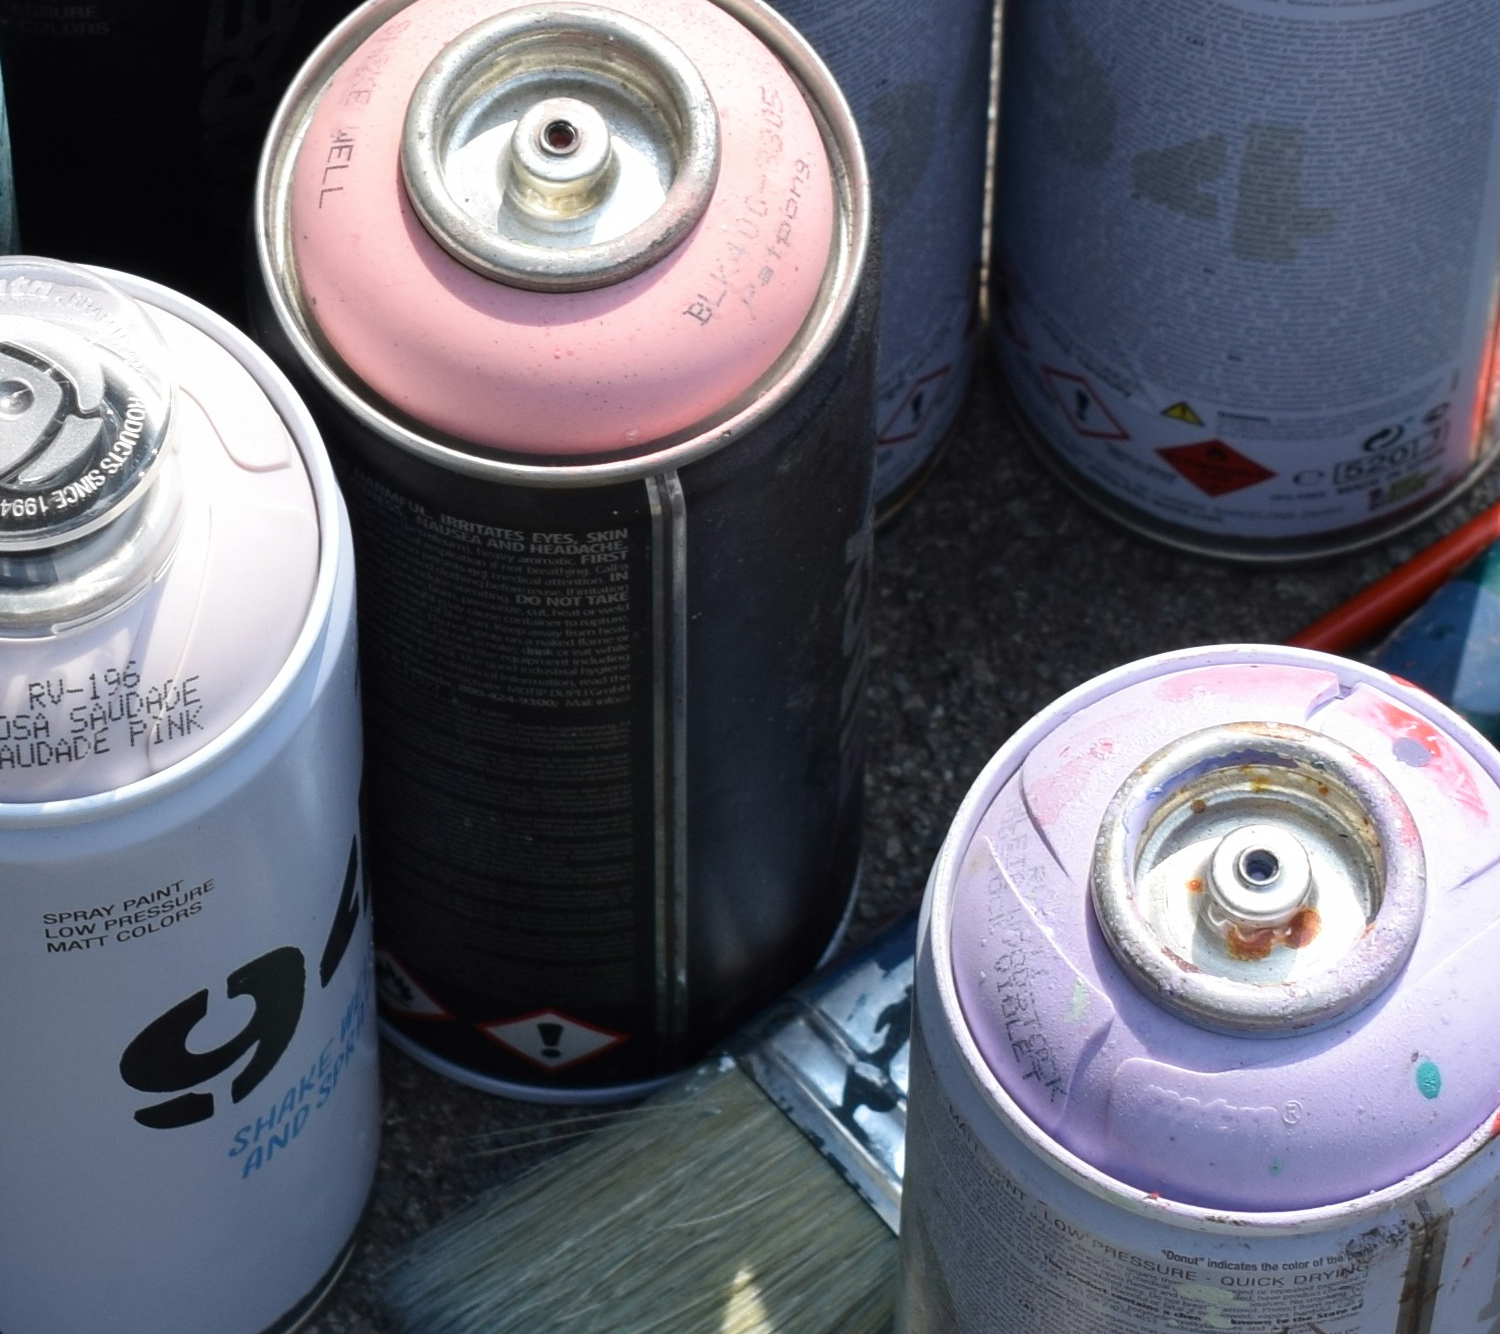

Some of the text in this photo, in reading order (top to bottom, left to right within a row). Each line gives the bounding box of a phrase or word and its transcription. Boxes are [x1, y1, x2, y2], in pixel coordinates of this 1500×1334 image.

[0, 497, 51, 518] 1994
[47, 466, 110, 511] SINCE
[415, 516, 630, 556] NAUSEA AND HEADACHE.
[439, 514, 629, 546] IRRITATES EYES, SKIN
[580, 550, 629, 565] FIRST
[609, 571, 629, 583] IN
[515, 591, 630, 607] DO NOT TAKE
[27, 660, 141, 710] RV-196
[69, 674, 202, 734] SAUDADE
[128, 704, 205, 748] PINK
[42, 879, 185, 925] SPRAY PAINT
[44, 877, 216, 940] LOW PRESSURE
[46, 900, 204, 954] MATT COLORS
[227, 1036, 336, 1158] SHAKE
[241, 1103, 312, 1180] AND
[1042, 1210, 1084, 1241] LOW
[1092, 1239, 1198, 1283] PRESSURE
[1220, 1274, 1285, 1288] QUICK
[1160, 1249, 1205, 1267] "Donut"
[1206, 1256, 1259, 1272] indicates
[1260, 1260, 1280, 1272] the
[1281, 1259, 1310, 1273] color
